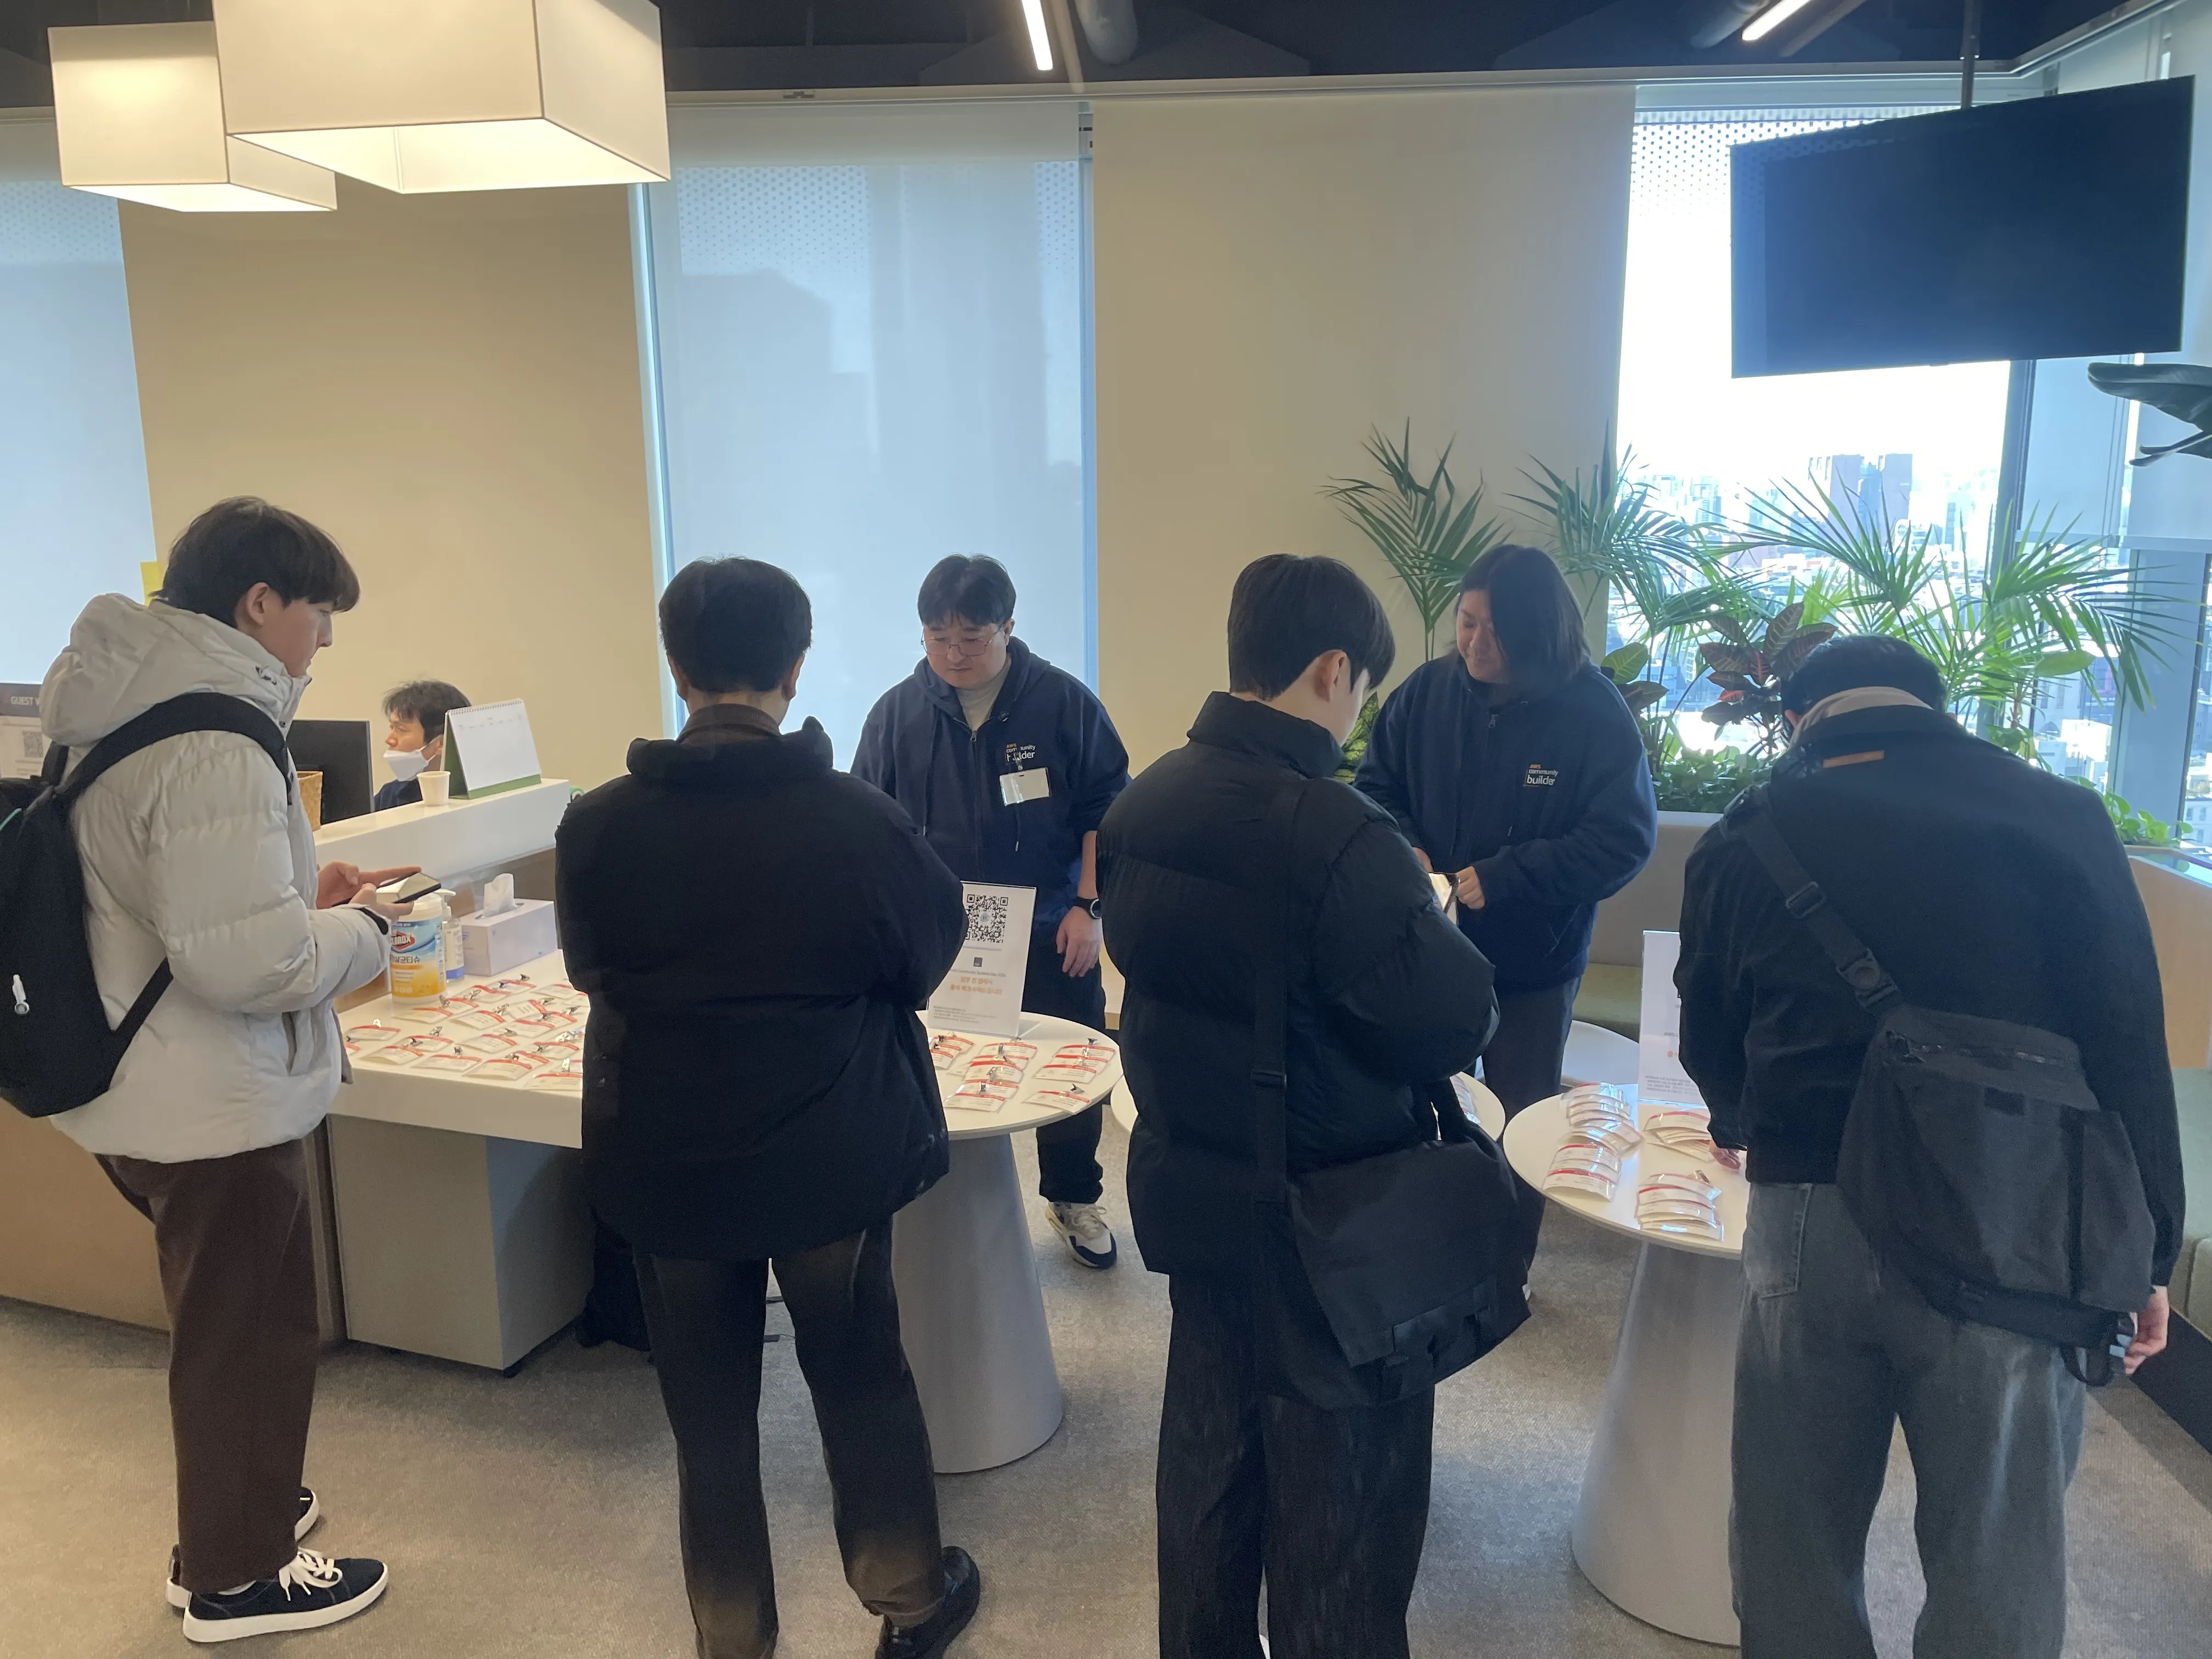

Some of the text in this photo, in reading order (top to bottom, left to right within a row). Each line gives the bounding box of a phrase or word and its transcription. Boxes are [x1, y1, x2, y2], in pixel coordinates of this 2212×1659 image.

[11, 696, 33, 706] GUEST
[1528, 769, 1559, 777] community
[1526, 774, 1555, 786] builder
[391, 934, 411, 945] LOROX
